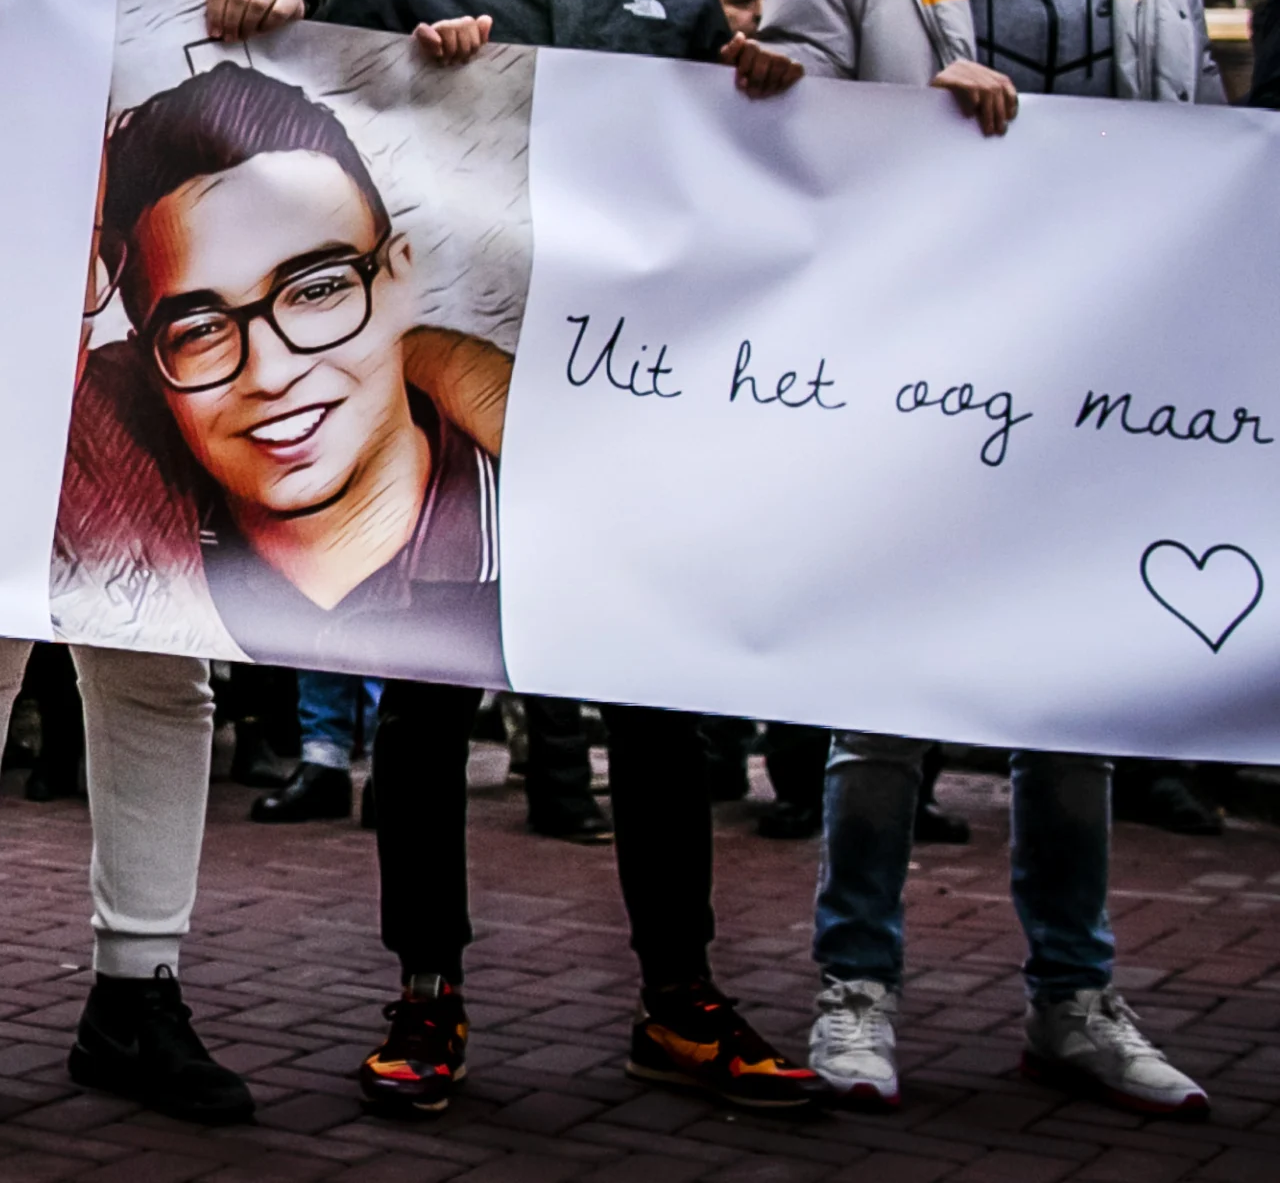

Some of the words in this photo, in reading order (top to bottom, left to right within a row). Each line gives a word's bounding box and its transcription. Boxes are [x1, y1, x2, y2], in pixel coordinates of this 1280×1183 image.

[566, 314, 682, 398] Uit
[730, 340, 847, 410] het
[895, 379, 1033, 468] oog
[1074, 389, 1275, 445] maar
